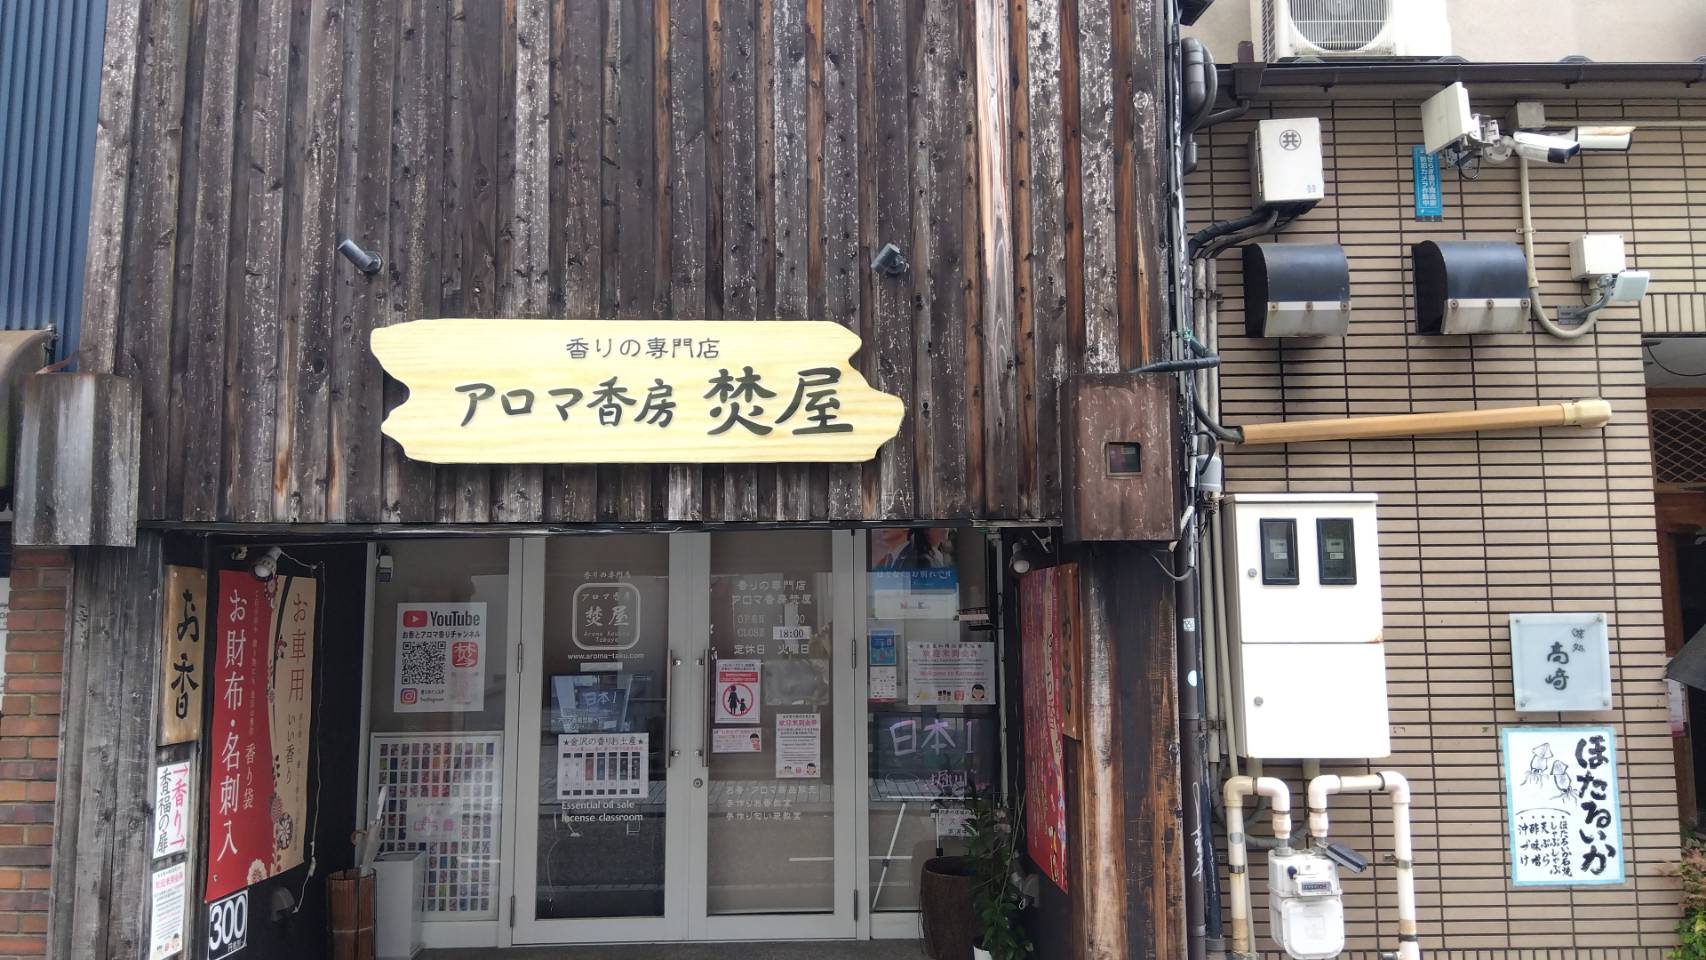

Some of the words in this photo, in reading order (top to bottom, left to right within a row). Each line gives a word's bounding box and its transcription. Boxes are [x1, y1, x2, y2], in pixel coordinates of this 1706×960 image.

[565, 337, 721, 360] 香りの専門店
[454, 376, 678, 428] アロマ香房
[702, 366, 855, 437] 焚屋
[735, 579, 808, 592] 香りの専門店
[430, 610, 481, 627] YouTube
[585, 605, 630, 627] 焚屋
[779, 629, 804, 639] 18:00
[171, 588, 200, 719] お香
[288, 594, 308, 702] お車用
[734, 644, 766, 656] 定休日
[777, 644, 810, 656] 火曜日
[217, 588, 248, 863] お財布・名刺入
[285, 713, 296, 784] いい香り
[243, 743, 256, 810] 香り袋
[172, 778, 187, 836] 香り
[561, 800, 600, 810] Essential
[602, 800, 614, 810] oil
[616, 800, 636, 810] sale
[561, 812, 596, 823] Incense
[598, 812, 644, 823] classroom
[1575, 734, 1617, 876] ほたるいか
[1518, 822, 1529, 866] 沖づけ
[1540, 821, 1551, 867] 天ぷら
[210, 895, 246, 950] 300
